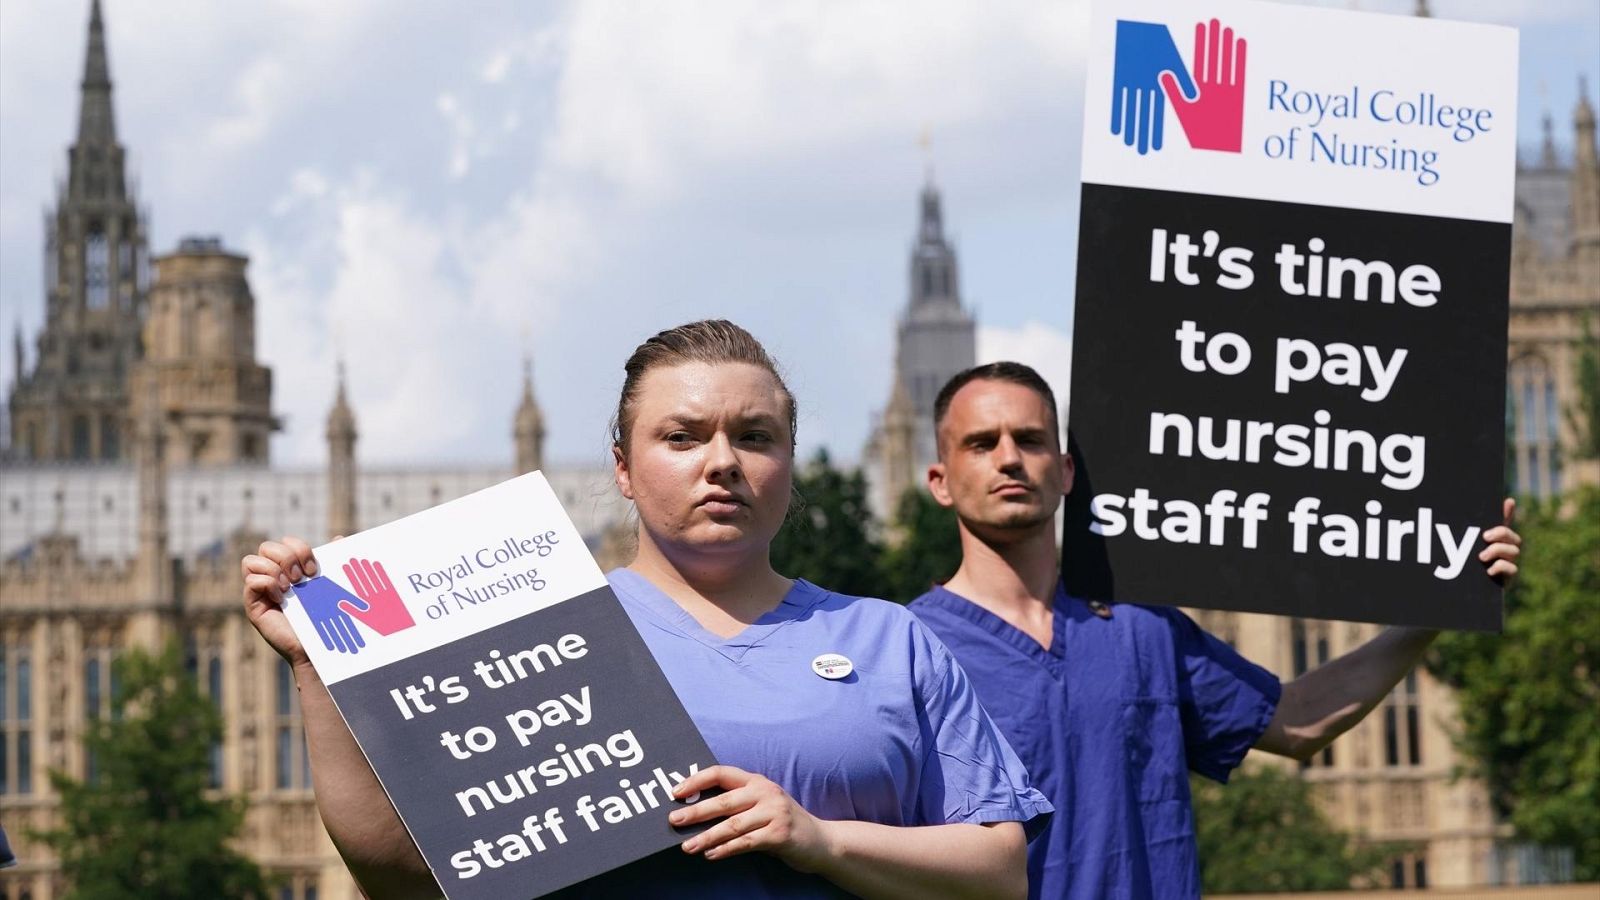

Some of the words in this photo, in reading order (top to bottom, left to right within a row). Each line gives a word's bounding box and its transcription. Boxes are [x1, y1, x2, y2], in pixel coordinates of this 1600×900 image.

[1269, 80, 1357, 126] Royal
[1370, 92, 1492, 142] College
[1265, 128, 1300, 159] of
[1311, 132, 1439, 186] Nursing
[1150, 229, 1254, 289] It’s
[1275, 238, 1441, 307] time
[1176, 321, 1251, 375] to
[1275, 338, 1408, 401] pay
[1150, 411, 1425, 490] nursing
[408, 556, 474, 597] Royal
[476, 531, 559, 568] College
[1090, 488, 1270, 548] staff
[1288, 497, 1480, 579] fairly
[426, 595, 449, 619] of
[452, 569, 546, 609] Nursing
[390, 676, 469, 720] It’s
[474, 634, 588, 688] time
[440, 726, 496, 759] to
[506, 686, 591, 746] pay
[456, 730, 643, 817] nursing
[451, 808, 568, 878] staff
